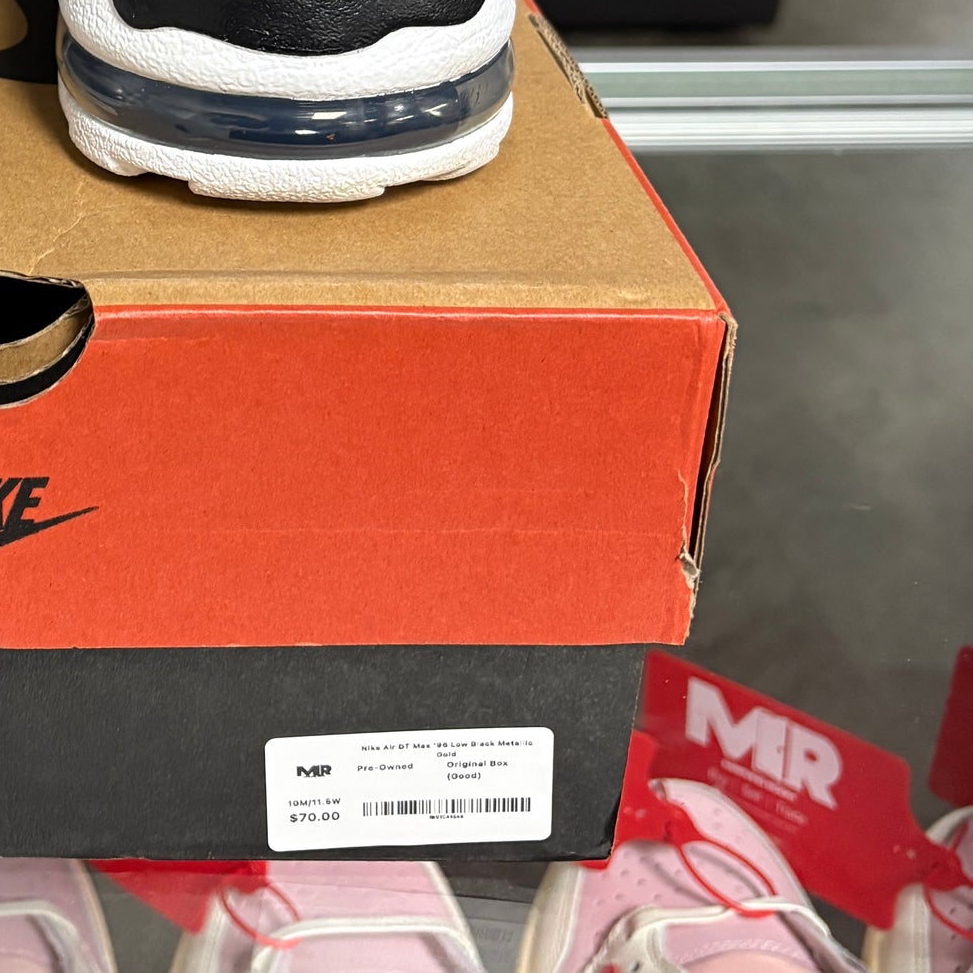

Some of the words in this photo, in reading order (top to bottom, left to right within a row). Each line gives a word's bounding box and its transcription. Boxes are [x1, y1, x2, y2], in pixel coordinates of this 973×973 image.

[357, 763, 414, 772] Pre-Owned
[446, 760, 487, 769] Original
[446, 772, 482, 781] (Good)
[289, 811, 341, 823] $70.00
